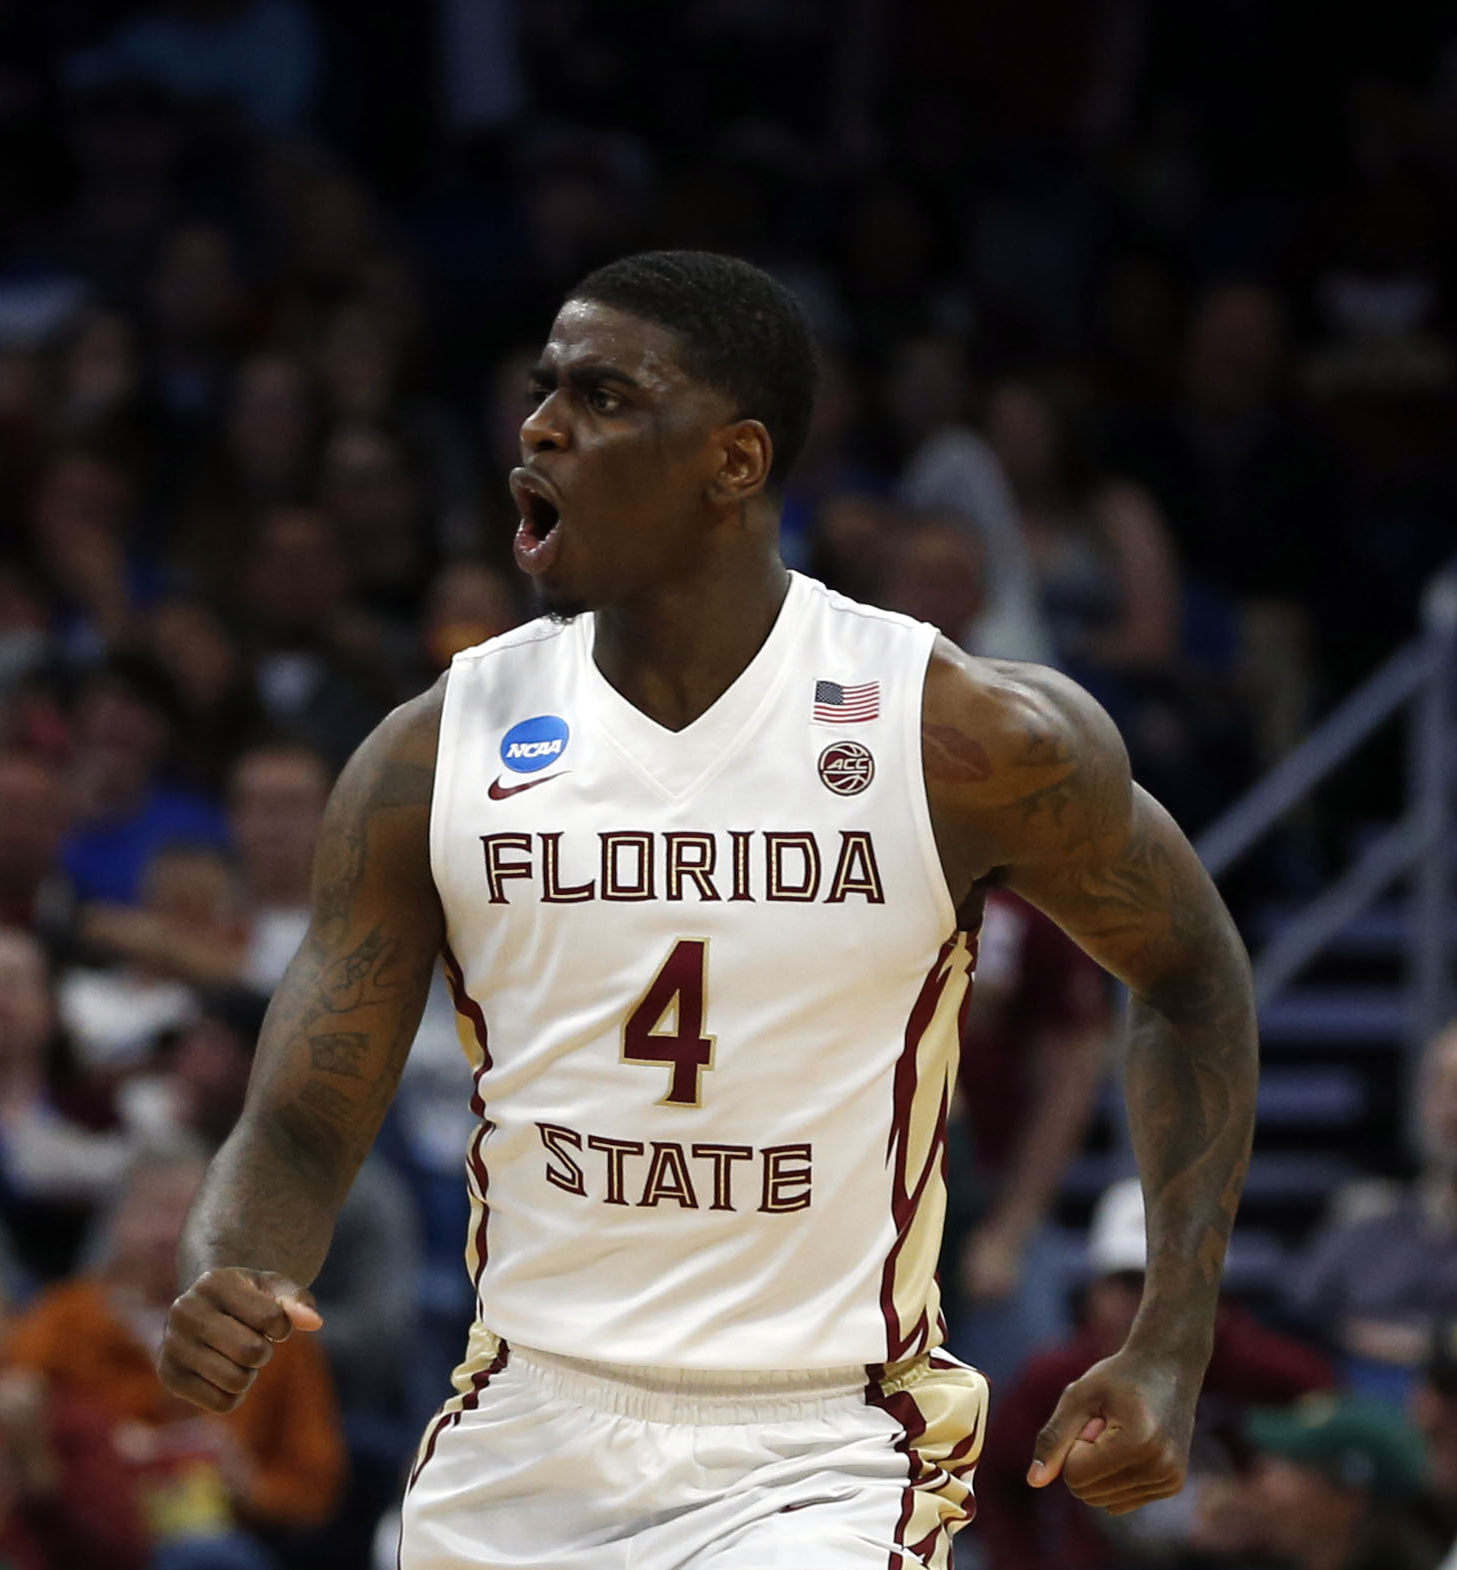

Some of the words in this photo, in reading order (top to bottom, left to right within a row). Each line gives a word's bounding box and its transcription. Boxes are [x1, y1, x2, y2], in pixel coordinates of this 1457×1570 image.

[506, 739, 562, 758] NCAA
[827, 757, 869, 770] ACC
[479, 831, 886, 904] FLORIDA
[619, 936, 717, 1108] 4
[534, 1121, 814, 1214] STATE
